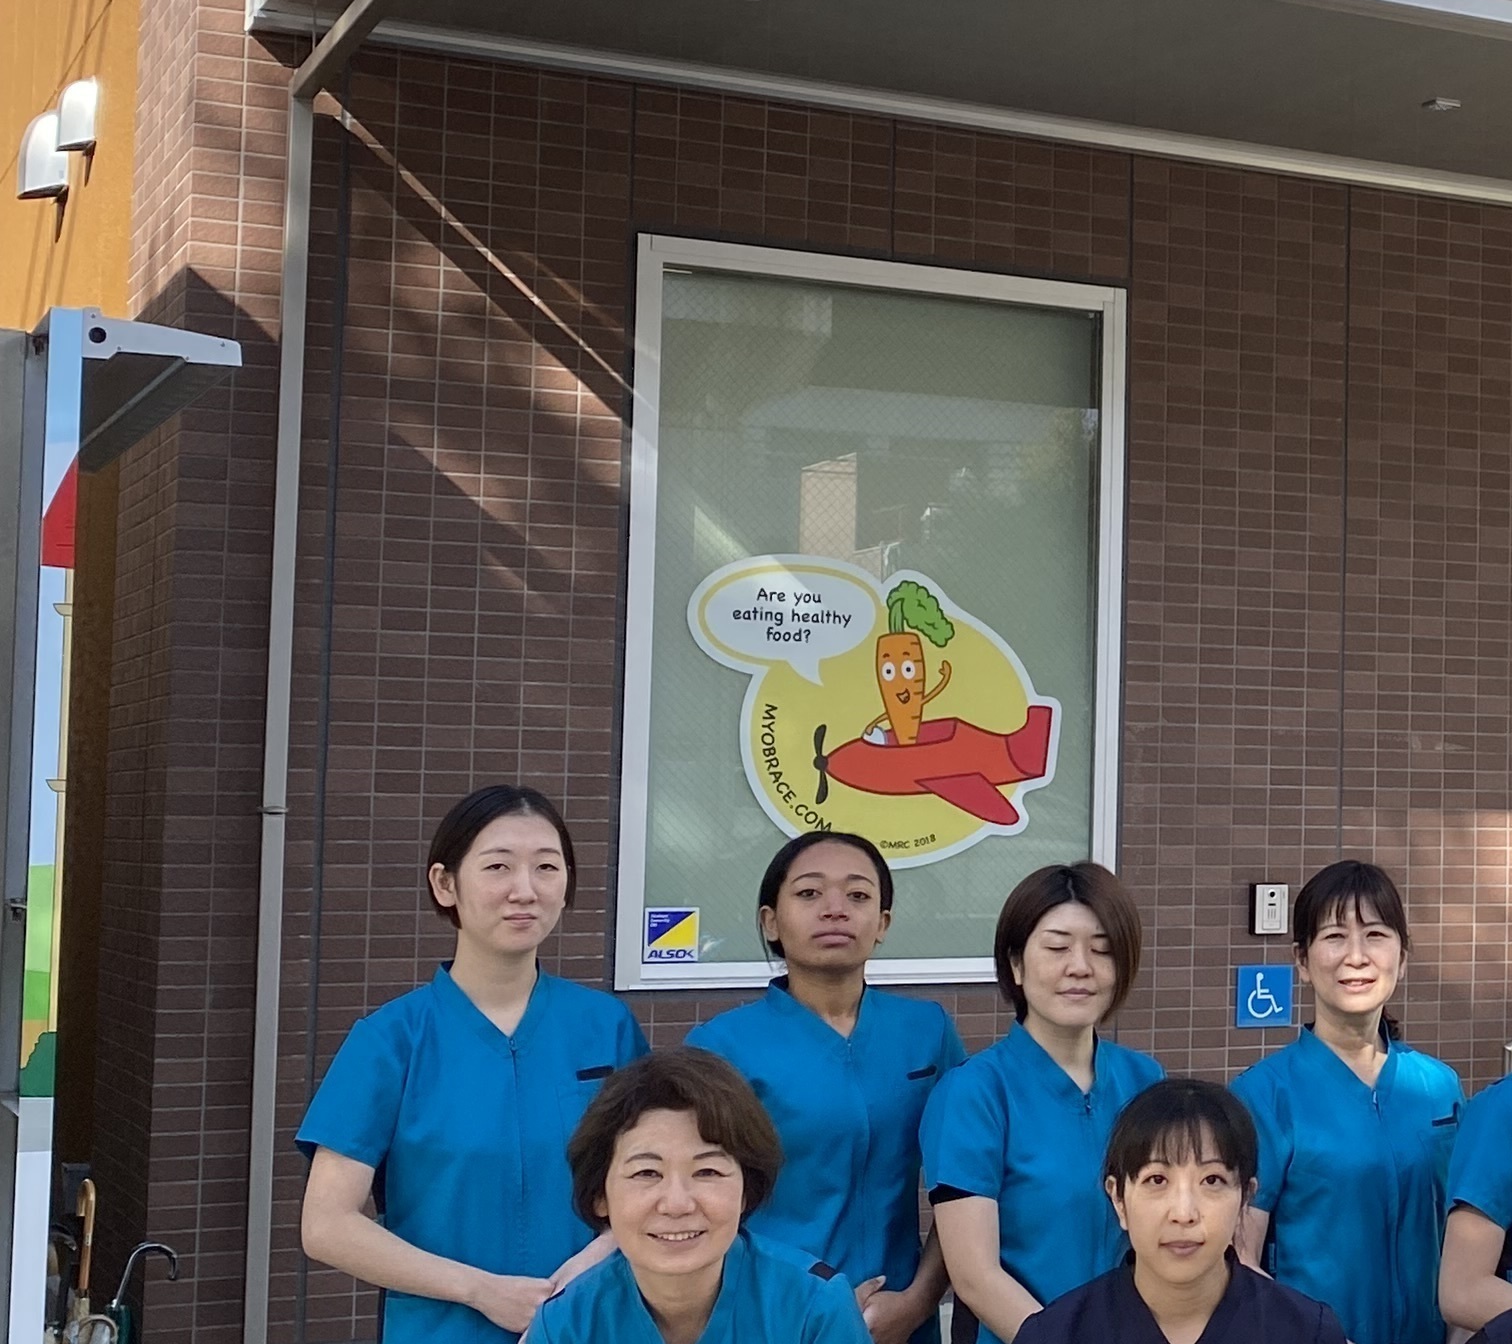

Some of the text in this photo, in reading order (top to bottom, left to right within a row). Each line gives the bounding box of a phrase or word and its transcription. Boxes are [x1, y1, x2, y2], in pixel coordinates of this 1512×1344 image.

[756, 587, 822, 606] Are you
[732, 607, 852, 628] eating healthy
[766, 627, 811, 643] food?
[761, 703, 832, 832] MYOBRACE.COM
[914, 833, 937, 847] 2018
[648, 949, 695, 959] ALSOK
